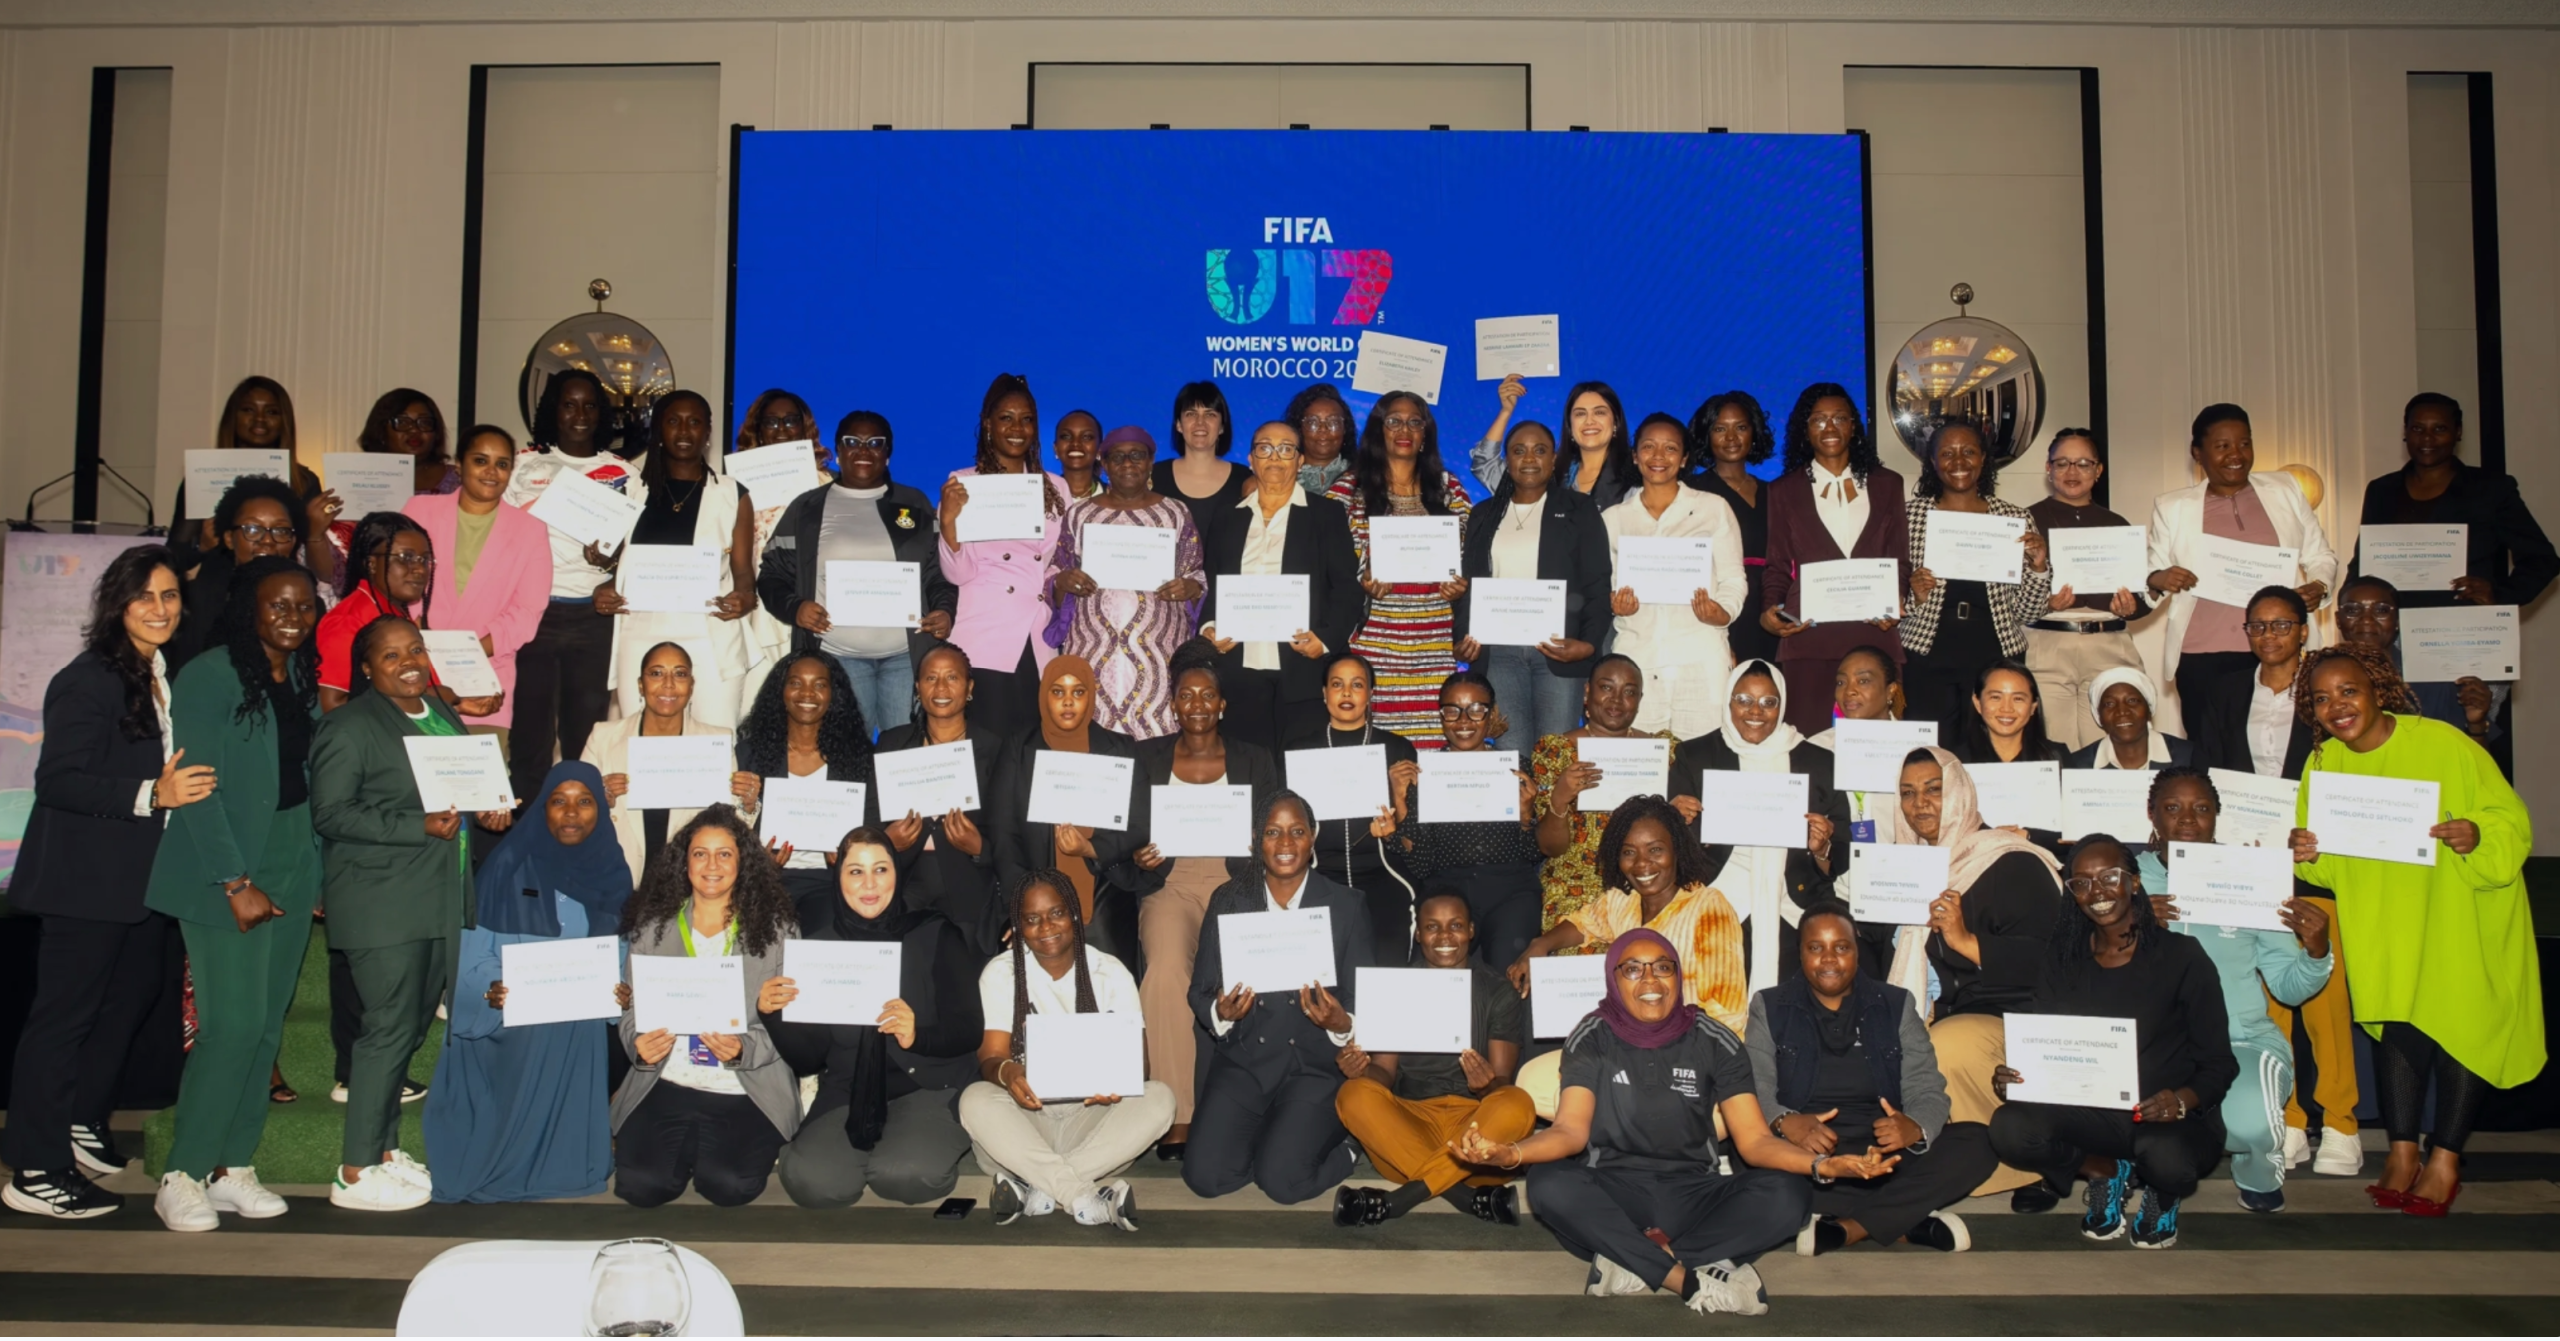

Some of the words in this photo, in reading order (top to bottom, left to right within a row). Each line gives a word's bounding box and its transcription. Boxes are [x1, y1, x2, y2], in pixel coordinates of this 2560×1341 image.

[1264, 217, 1334, 243] FIFA
[1206, 249, 1393, 325] U17
[1377, 310, 1385, 325] TM
[1206, 336, 1287, 352] WOMEN'S
[1291, 336, 1354, 352] WORLD
[1213, 358, 1327, 379] MOROCCO
[1333, 359, 1357, 379] 20
[1938, 528, 1968, 536] CERTIFICATE
[1977, 531, 2011, 539] ATTENDANCE
[2209, 552, 2240, 562] CERTIFICATE
[2249, 558, 2283, 570] ATTENDANCE
[2240, 571, 2263, 580] COLLET
[2419, 640, 2450, 648] ORNELLA
[2324, 793, 2363, 804] CERTIFICATE
[2376, 798, 2420, 809] ATTENDANCE
[2329, 808, 2375, 821] TSHOLOFELO
[2375, 813, 2414, 824] SETLHOKO
[2022, 1037, 2061, 1046] CERTIFICATE
[2074, 1040, 2118, 1049] ATTENDANCE
[2043, 1053, 2084, 1064] NYANDENG
[2085, 1056, 2099, 1065] WIL
[1672, 1067, 1697, 1079] FIFA
